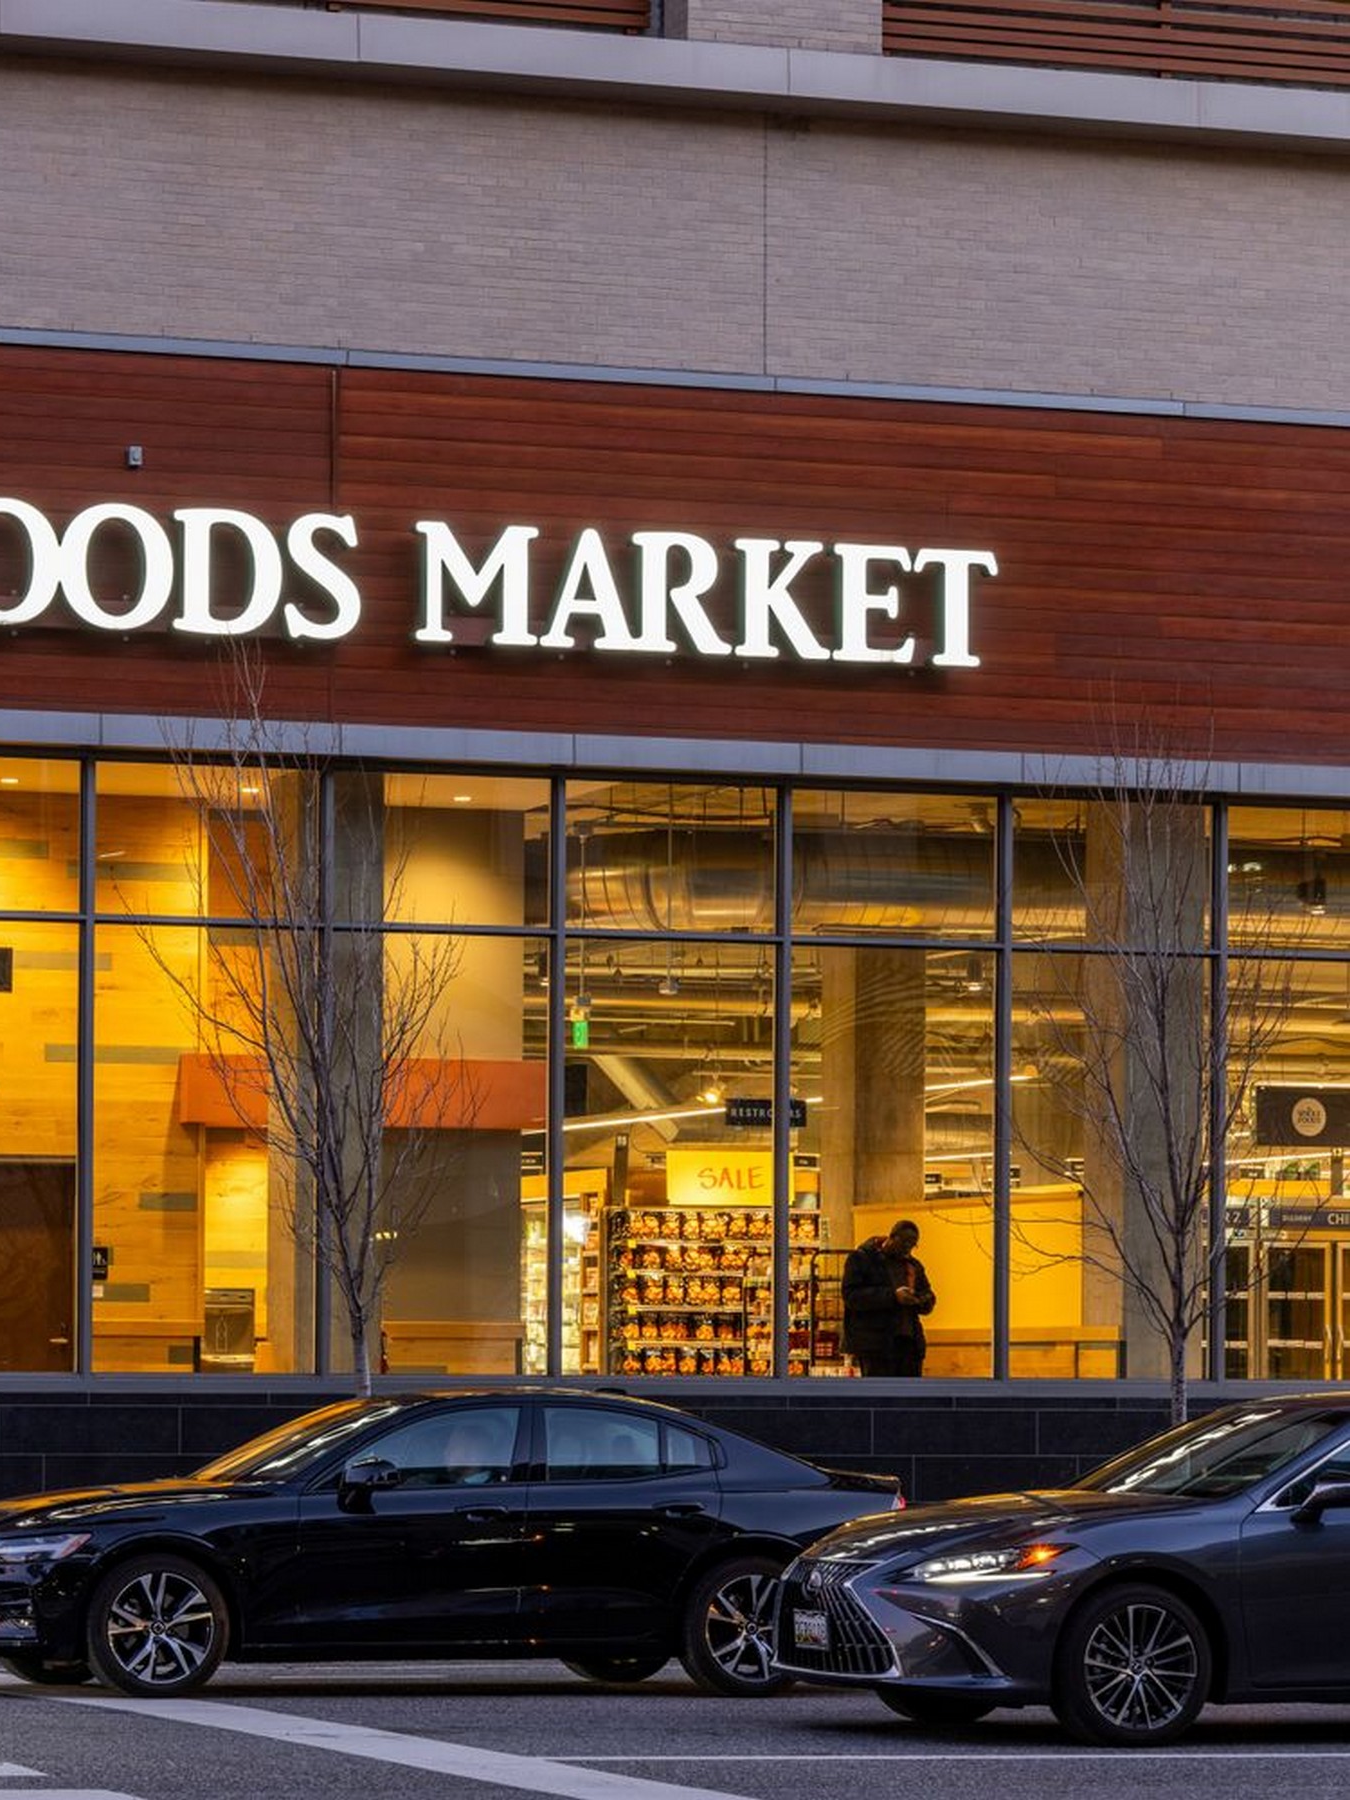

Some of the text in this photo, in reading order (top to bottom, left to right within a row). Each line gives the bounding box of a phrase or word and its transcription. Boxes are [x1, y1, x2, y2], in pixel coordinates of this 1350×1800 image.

[415, 521, 998, 667] MARKET
[731, 1107, 801, 1118] RESTROS
[697, 1166, 766, 1190] SALE
